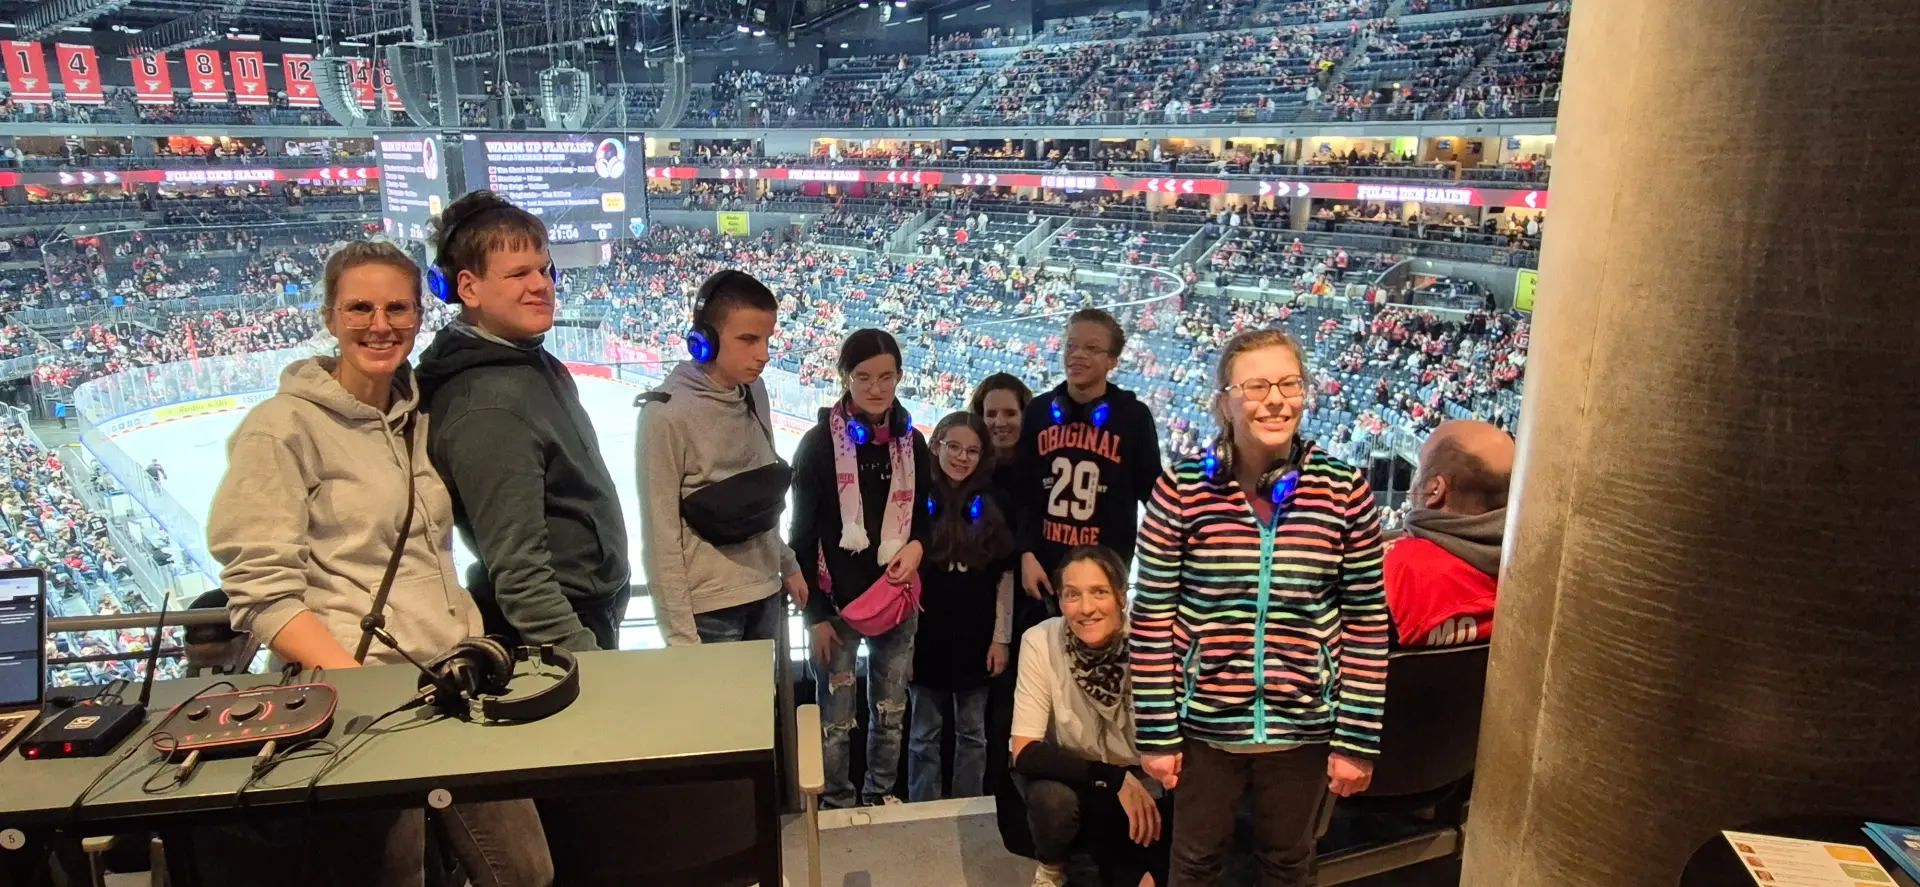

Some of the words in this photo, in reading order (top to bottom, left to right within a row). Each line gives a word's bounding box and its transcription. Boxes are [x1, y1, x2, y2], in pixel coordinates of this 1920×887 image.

[16, 46, 31, 74] 1
[68, 52, 88, 75] 4
[141, 55, 159, 76] 6
[195, 53, 213, 75] 8
[237, 57, 260, 79] 11
[288, 61, 312, 80] 12
[485, 142, 524, 153] WARM
[525, 142, 541, 153] UP
[542, 142, 594, 153] PLAYLIST
[165, 171, 205, 182] FOLGE
[1425, 188, 1472, 205] HAIEN
[548, 228, 579, 241] 21:04
[598, 229, 607, 240] 0
[178, 402, 205, 413] Radio
[1037, 421, 1122, 464] ORIGINAL
[1048, 456, 1100, 521] 29
[437, 794, 444, 804] 4
[8, 834, 16, 844] 5
